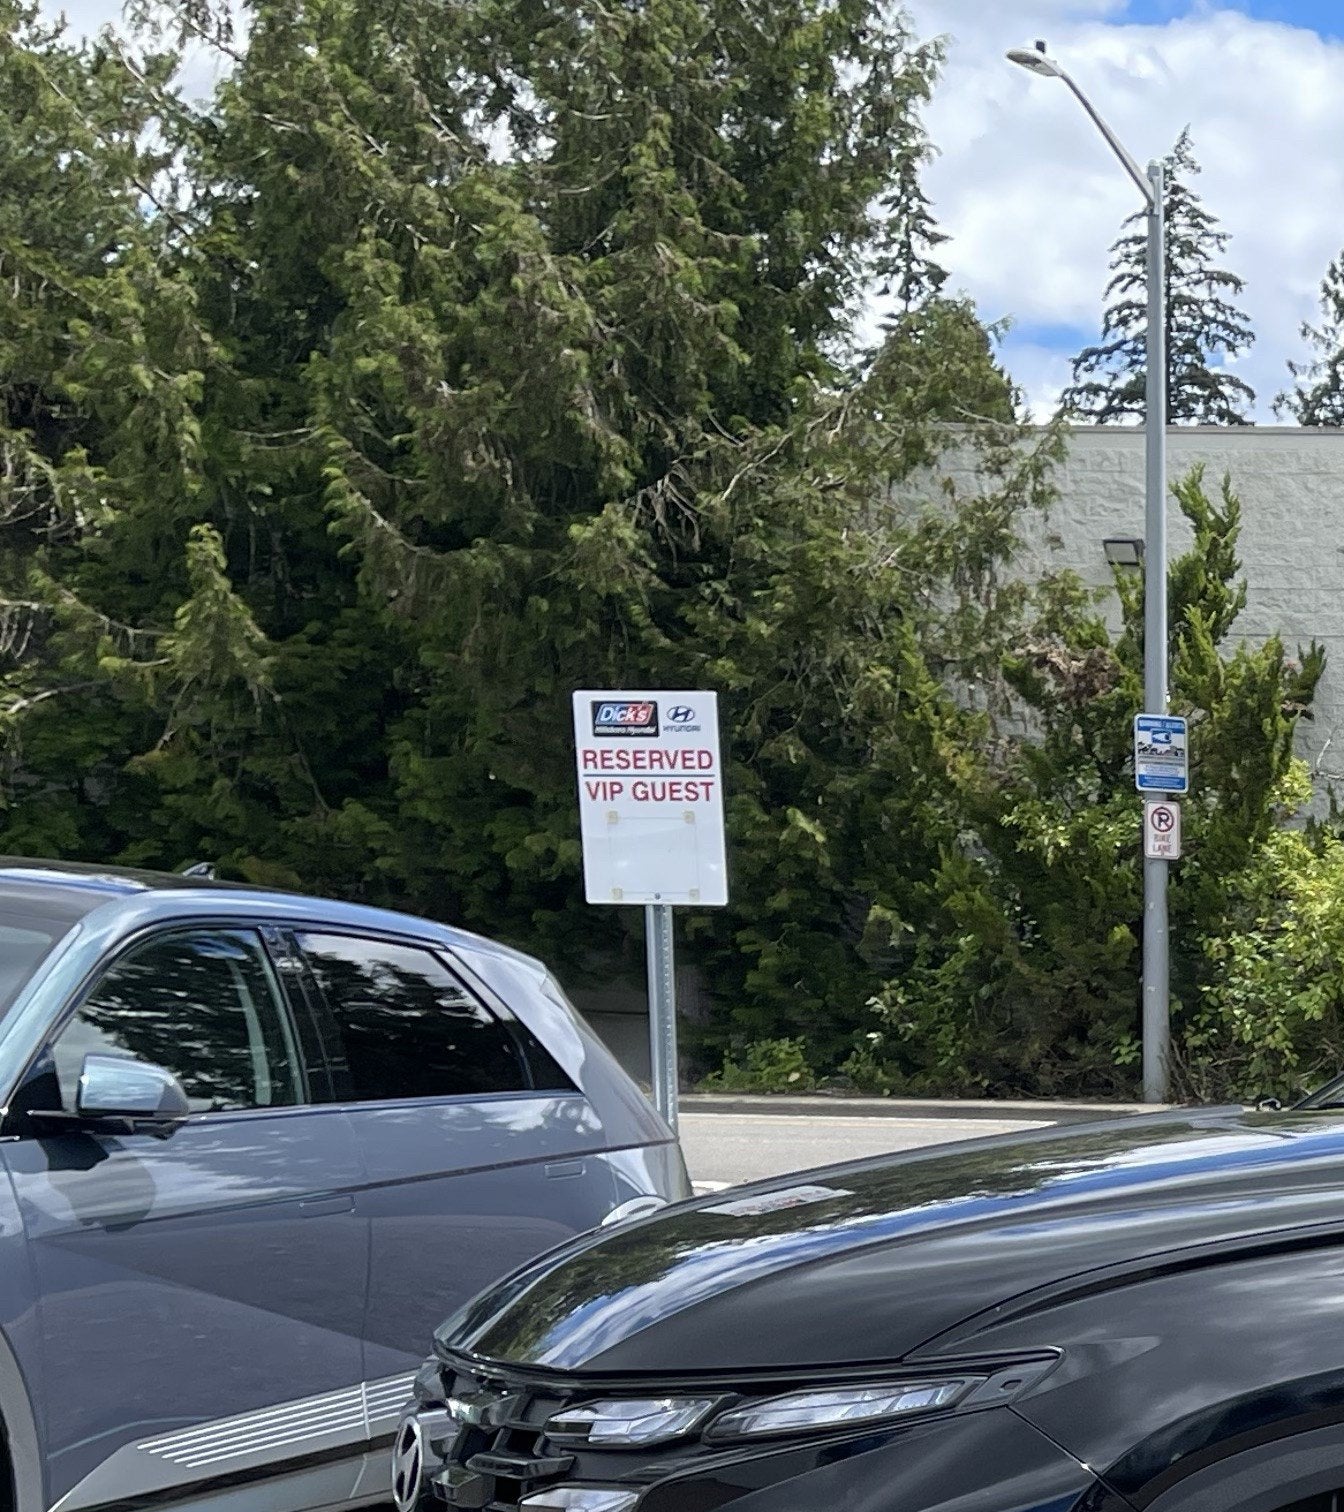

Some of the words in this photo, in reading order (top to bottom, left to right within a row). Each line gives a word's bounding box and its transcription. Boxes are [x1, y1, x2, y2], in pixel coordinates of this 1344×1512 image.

[583, 750, 713, 770] RESERVED
[586, 782, 624, 801] VIP
[632, 781, 714, 801] GUEST
